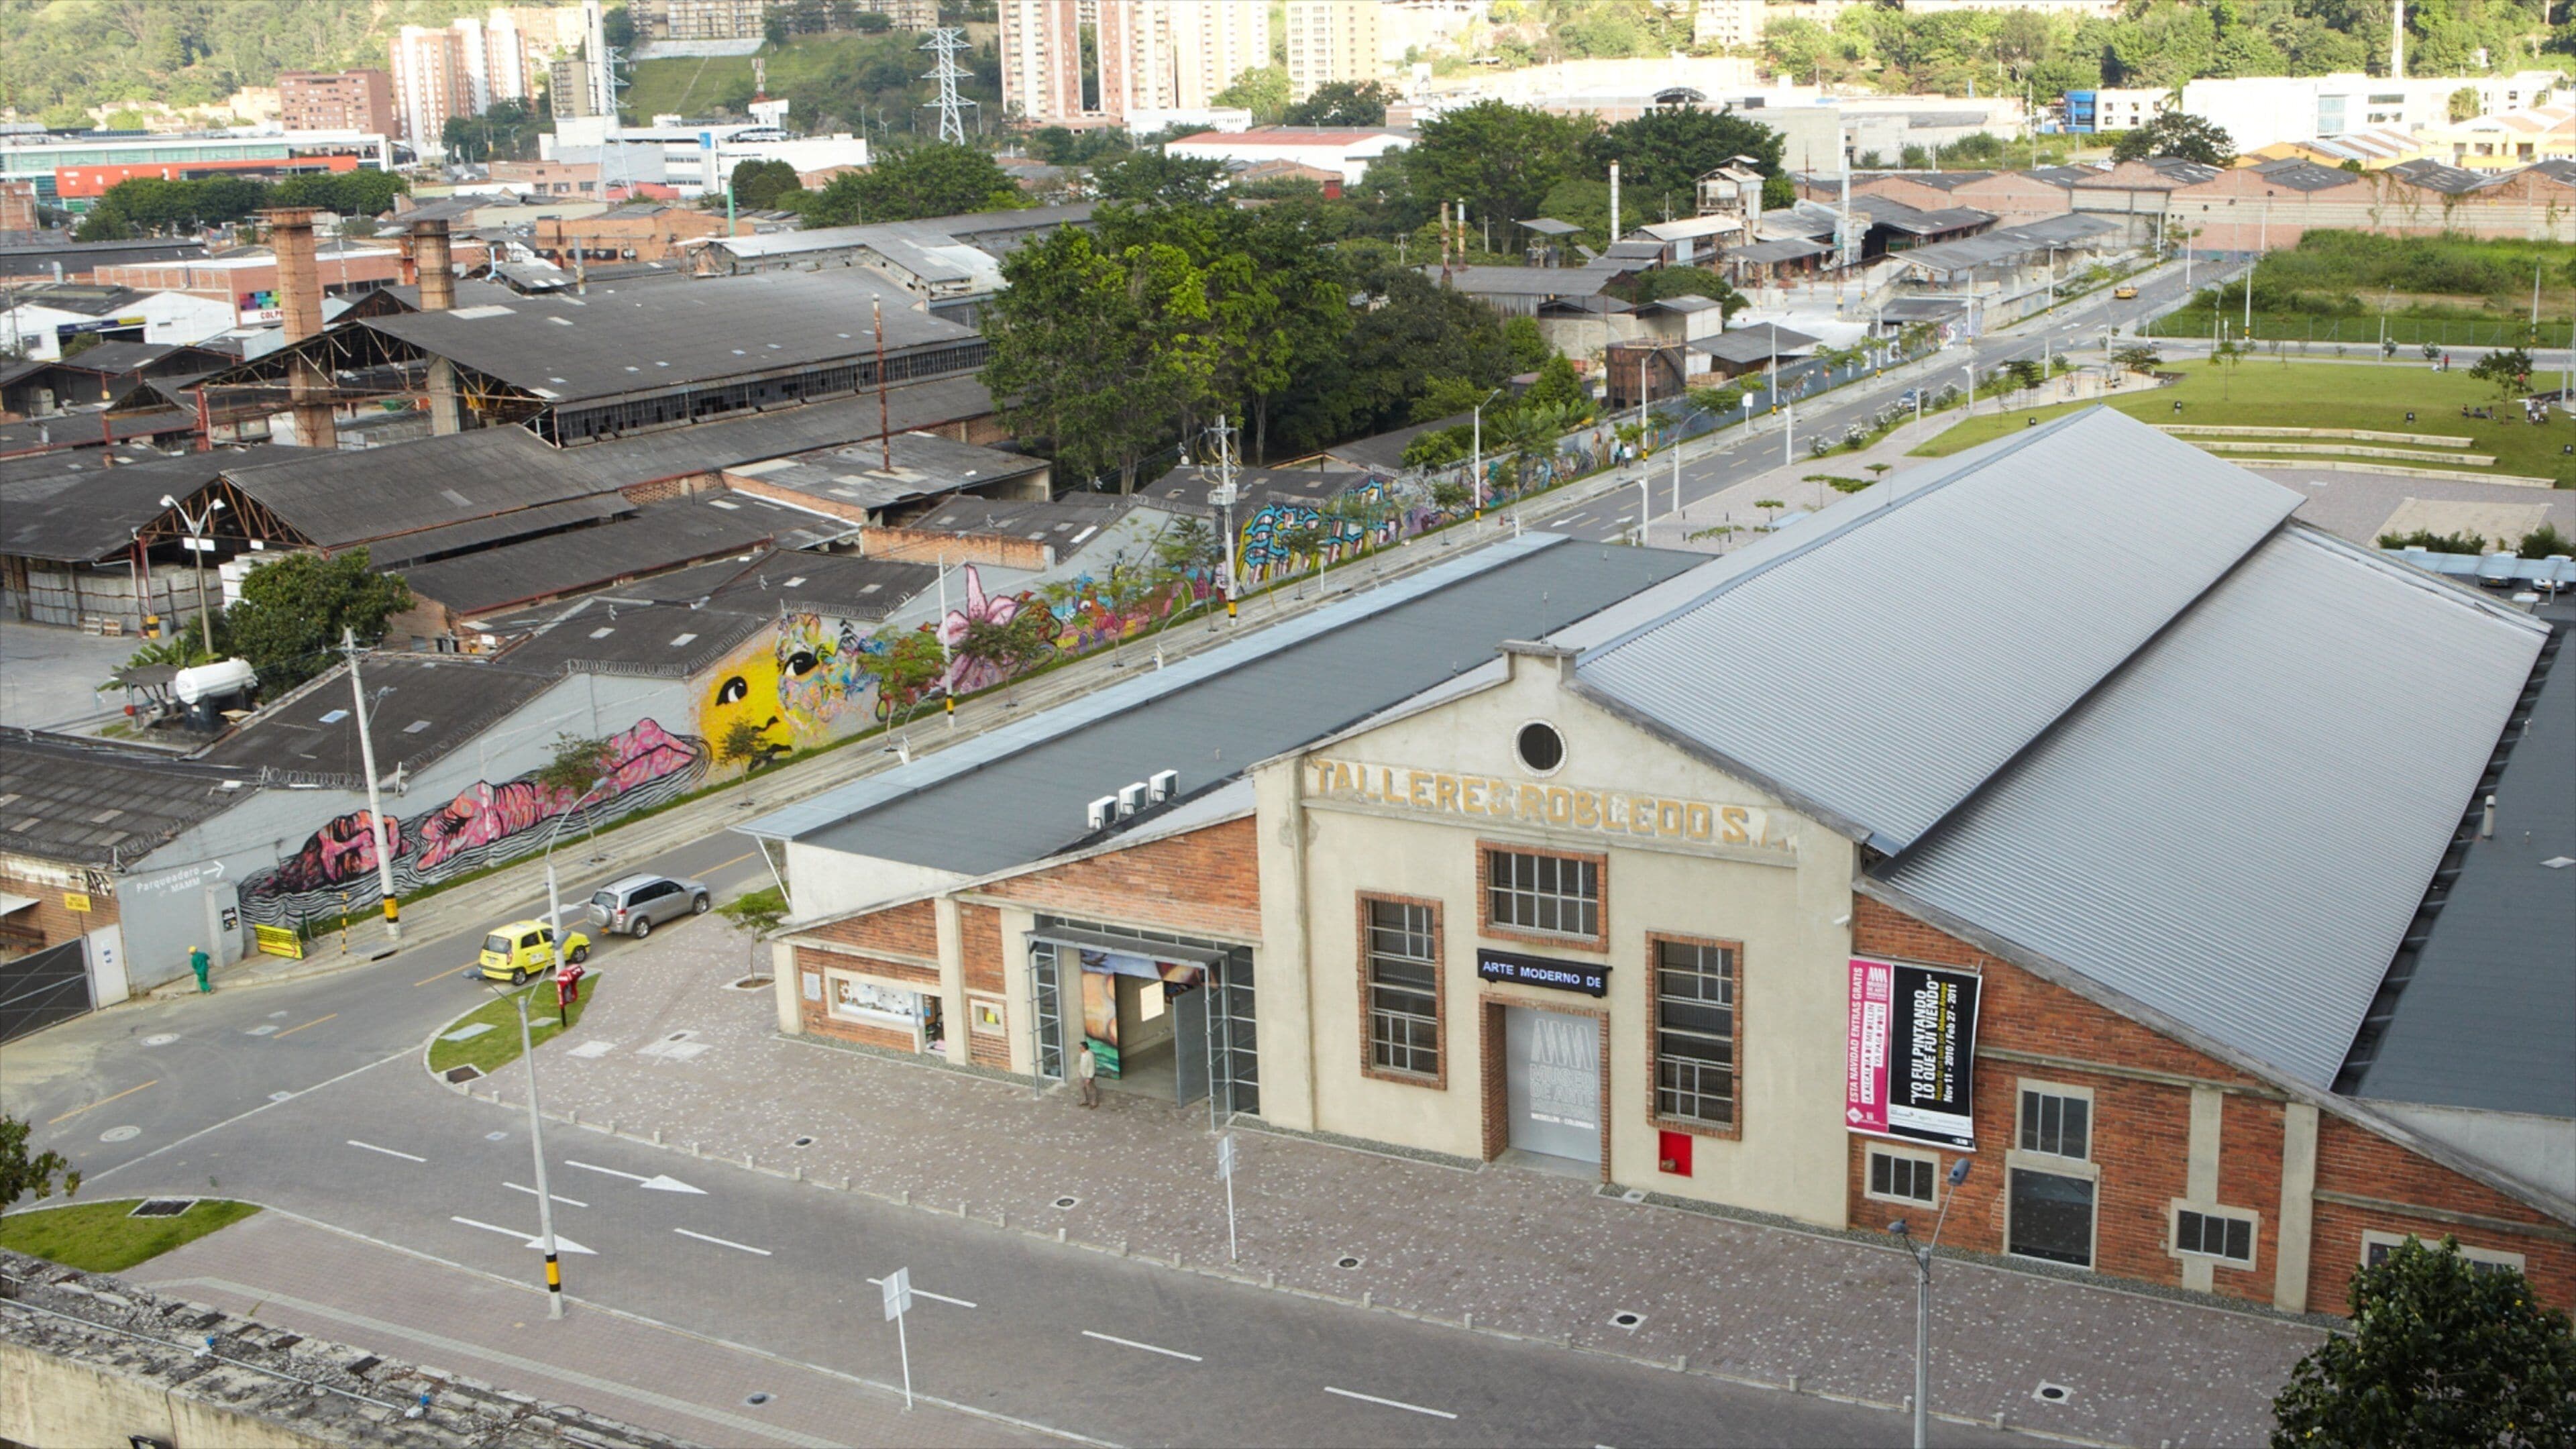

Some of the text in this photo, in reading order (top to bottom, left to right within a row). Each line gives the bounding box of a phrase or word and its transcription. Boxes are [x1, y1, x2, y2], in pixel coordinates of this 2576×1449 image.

[1314, 759, 1514, 816] TALLERES
[1519, 784, 1713, 842] ROBLEDO
[136, 867, 199, 893] Parqueadero
[1483, 961, 1601, 987] ARTE MODERNO DE
[1853, 967, 1863, 1000] GRATIS
[1947, 984, 1957, 1004] 2011
[1851, 1002, 1861, 1037] ENTRAS
[1913, 989, 1927, 1056] PINTANDO
[1947, 1010, 1956, 1022] 27
[1945, 1023, 1956, 1040] Feb
[1865, 1044, 1872, 1054] DE
[1925, 1032, 1937, 1053] FUI
[1850, 1040, 1860, 1080] NAVIDAD
[1945, 1046, 1954, 1067] 2010
[1529, 1063, 1595, 1091] MUSEO
[1911, 1059, 1924, 1079] FUI
[1923, 1055, 1936, 1081] QUE
[1944, 1074, 1953, 1083] 11
[1530, 1081, 1595, 1107] DE ARTE
[1849, 1083, 1859, 1102] ESTA
[1924, 1083, 1935, 1099] LO
[1943, 1085, 1953, 1103] Nov
